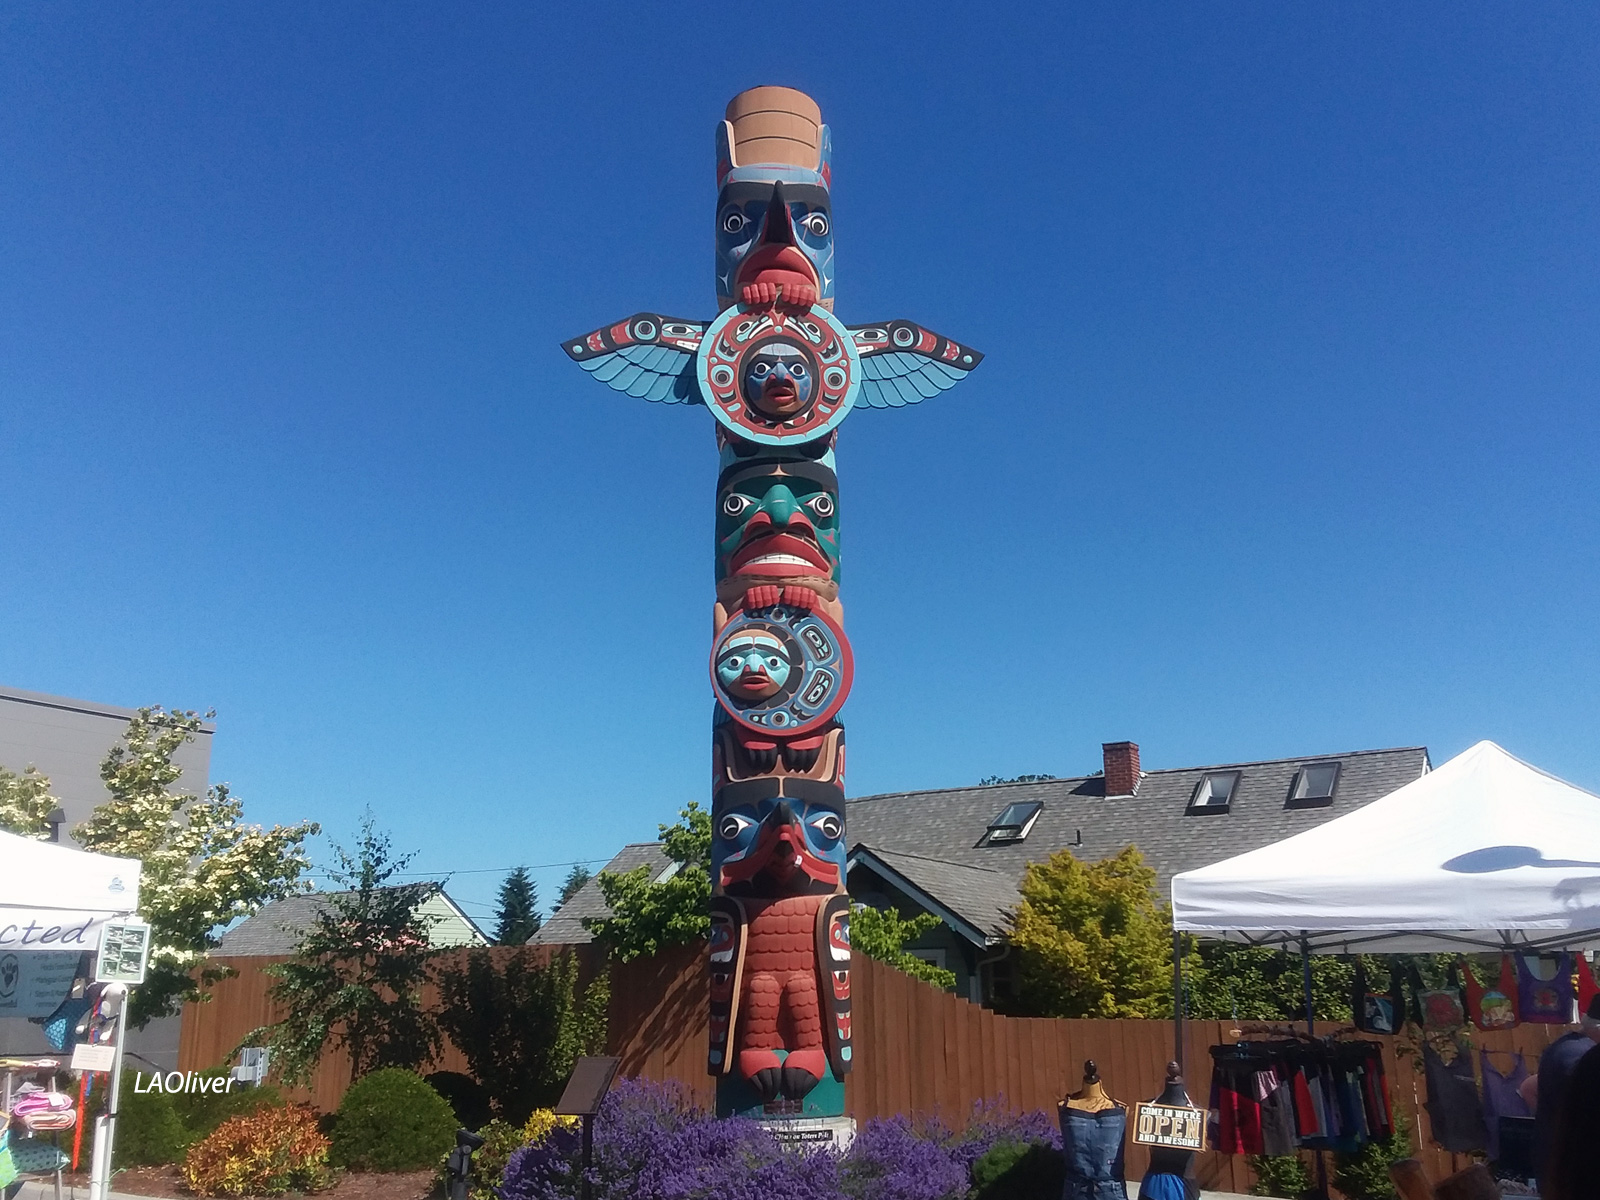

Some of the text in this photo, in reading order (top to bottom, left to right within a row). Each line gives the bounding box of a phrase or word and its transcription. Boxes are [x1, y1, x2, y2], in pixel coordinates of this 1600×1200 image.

[1141, 1107, 1163, 1116] COME
[1164, 1109, 1173, 1117] IN
[1138, 1114, 1201, 1140] OPEN
[1138, 1133, 1200, 1148] AND AWESOME
